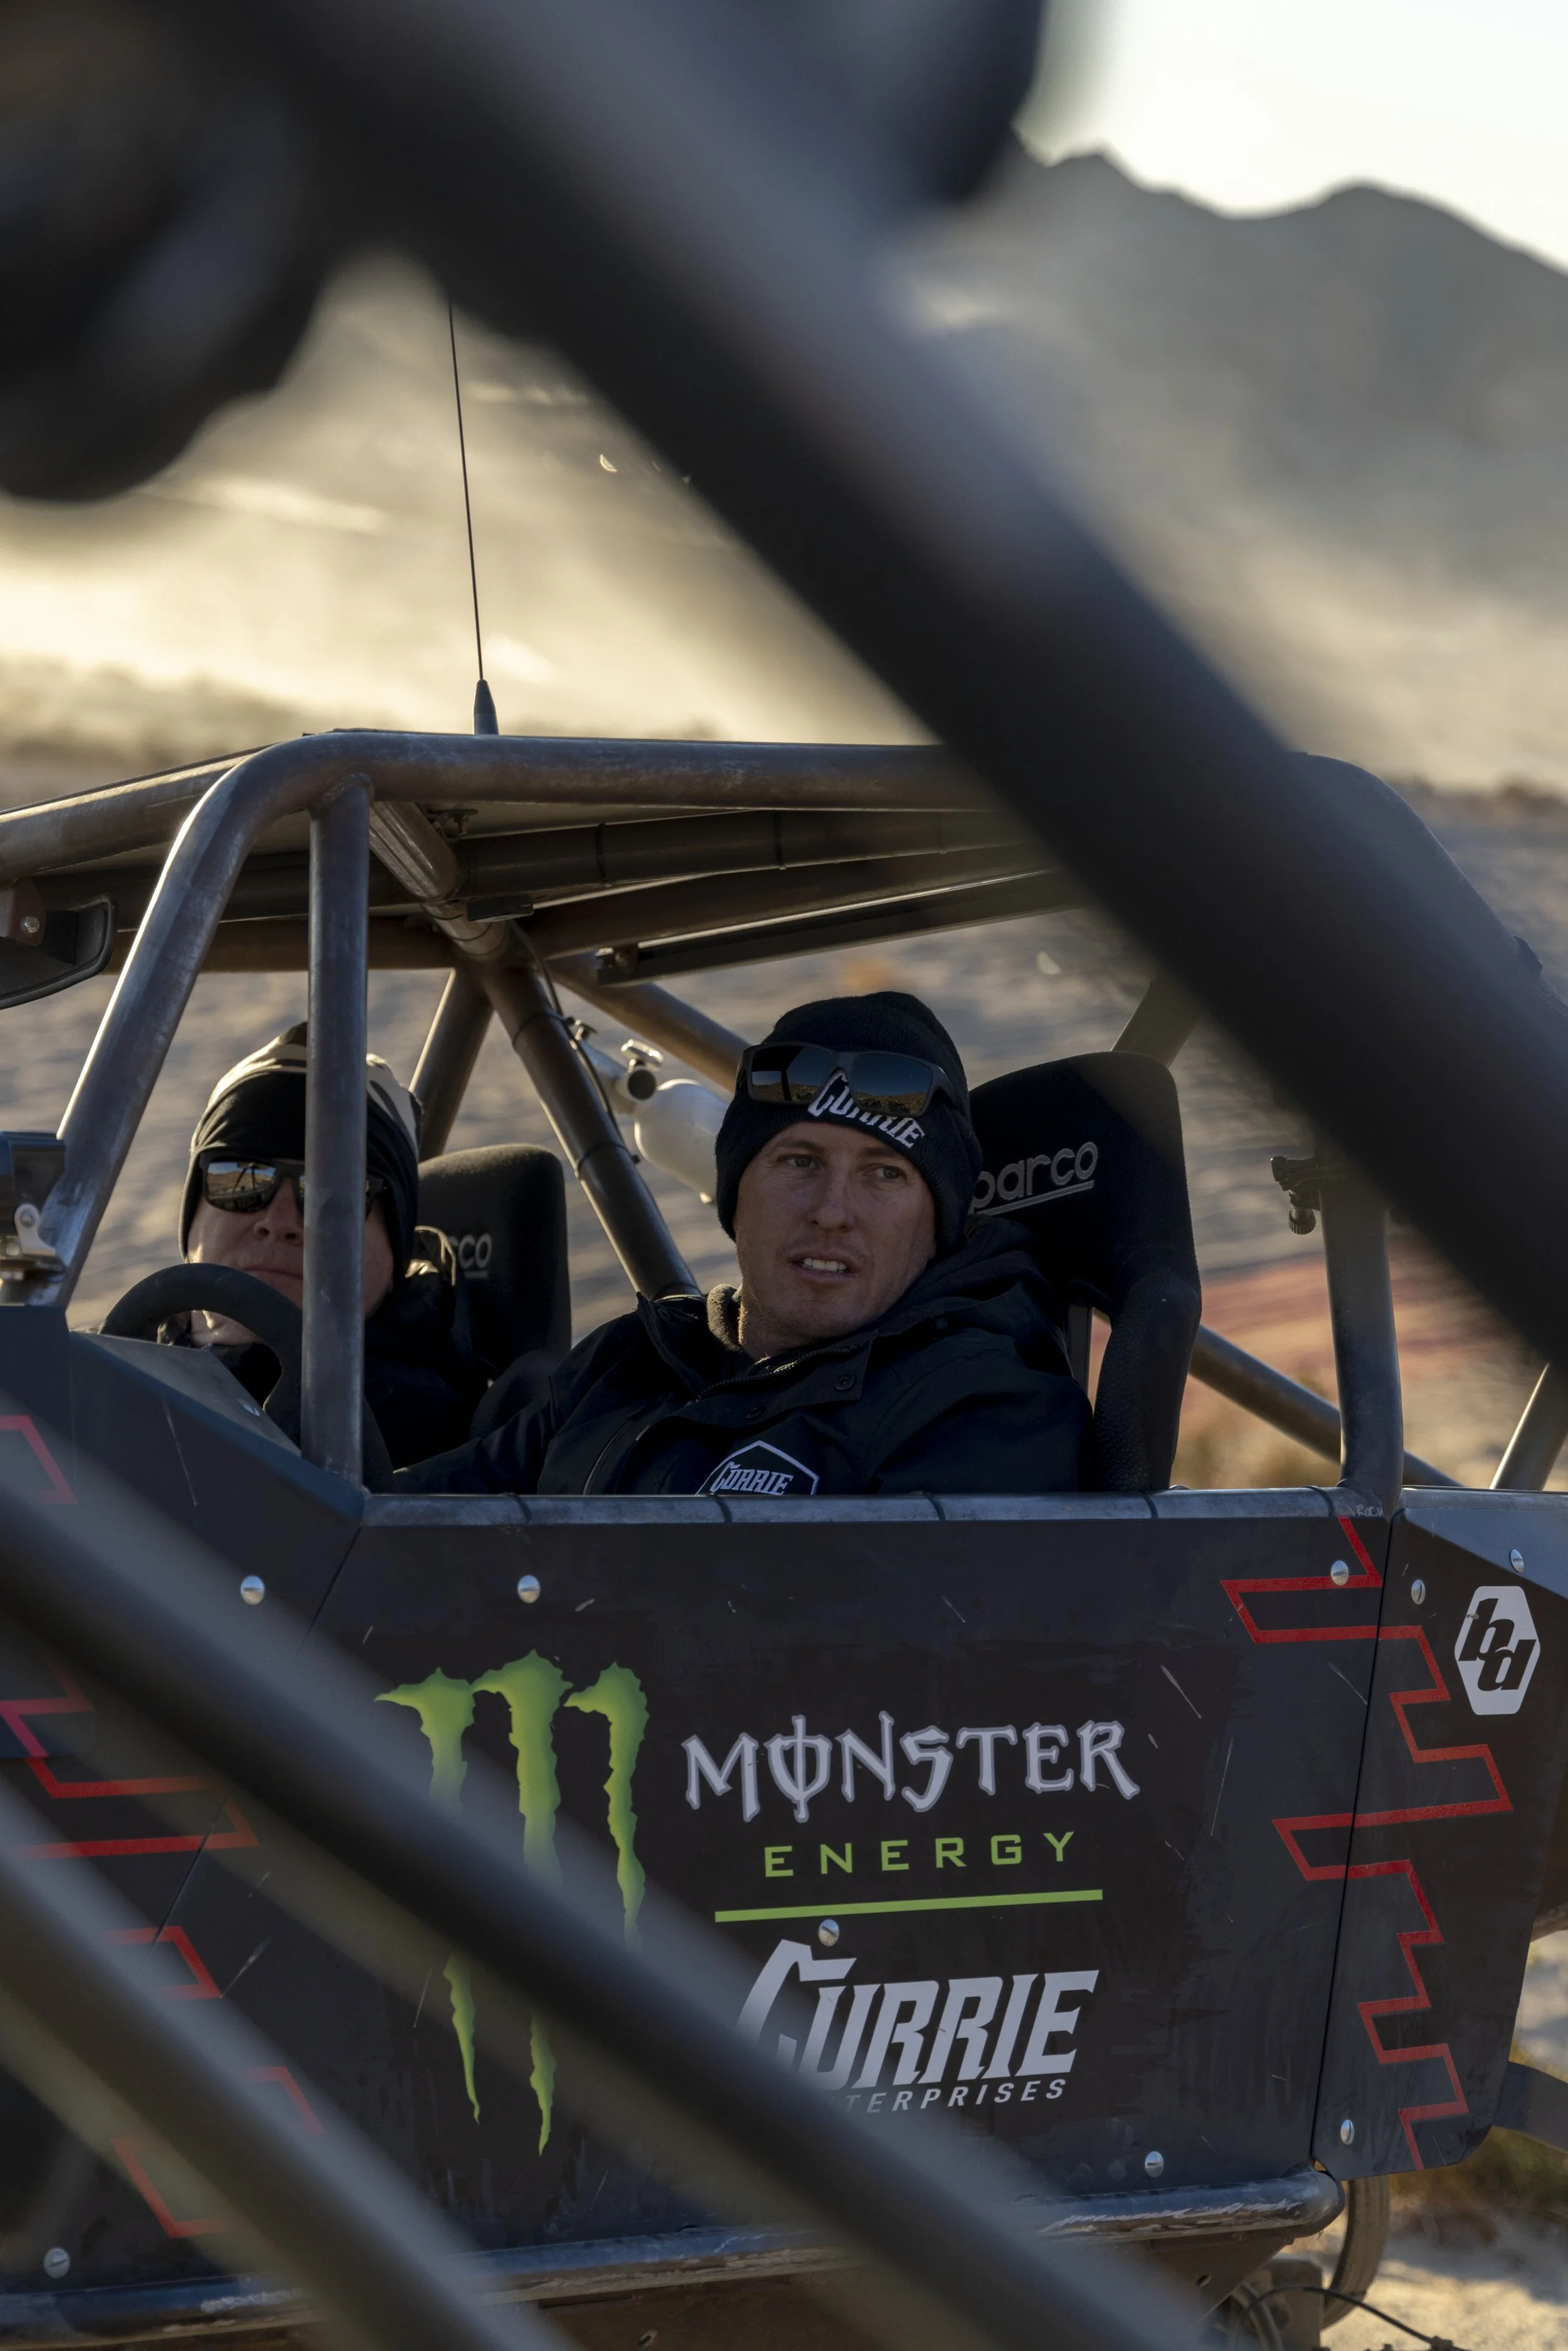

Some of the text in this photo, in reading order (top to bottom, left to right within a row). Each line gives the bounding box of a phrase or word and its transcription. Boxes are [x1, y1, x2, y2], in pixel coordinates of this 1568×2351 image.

[967, 1141, 1098, 1215] parco
[709, 1461, 794, 1495] CURRIE
[681, 1711, 1140, 1823] MONSTER
[765, 1831, 1075, 1878] ENERGY
[737, 1939, 1099, 2091] CURRIE
[839, 2079, 1066, 2113] TERPRISES
